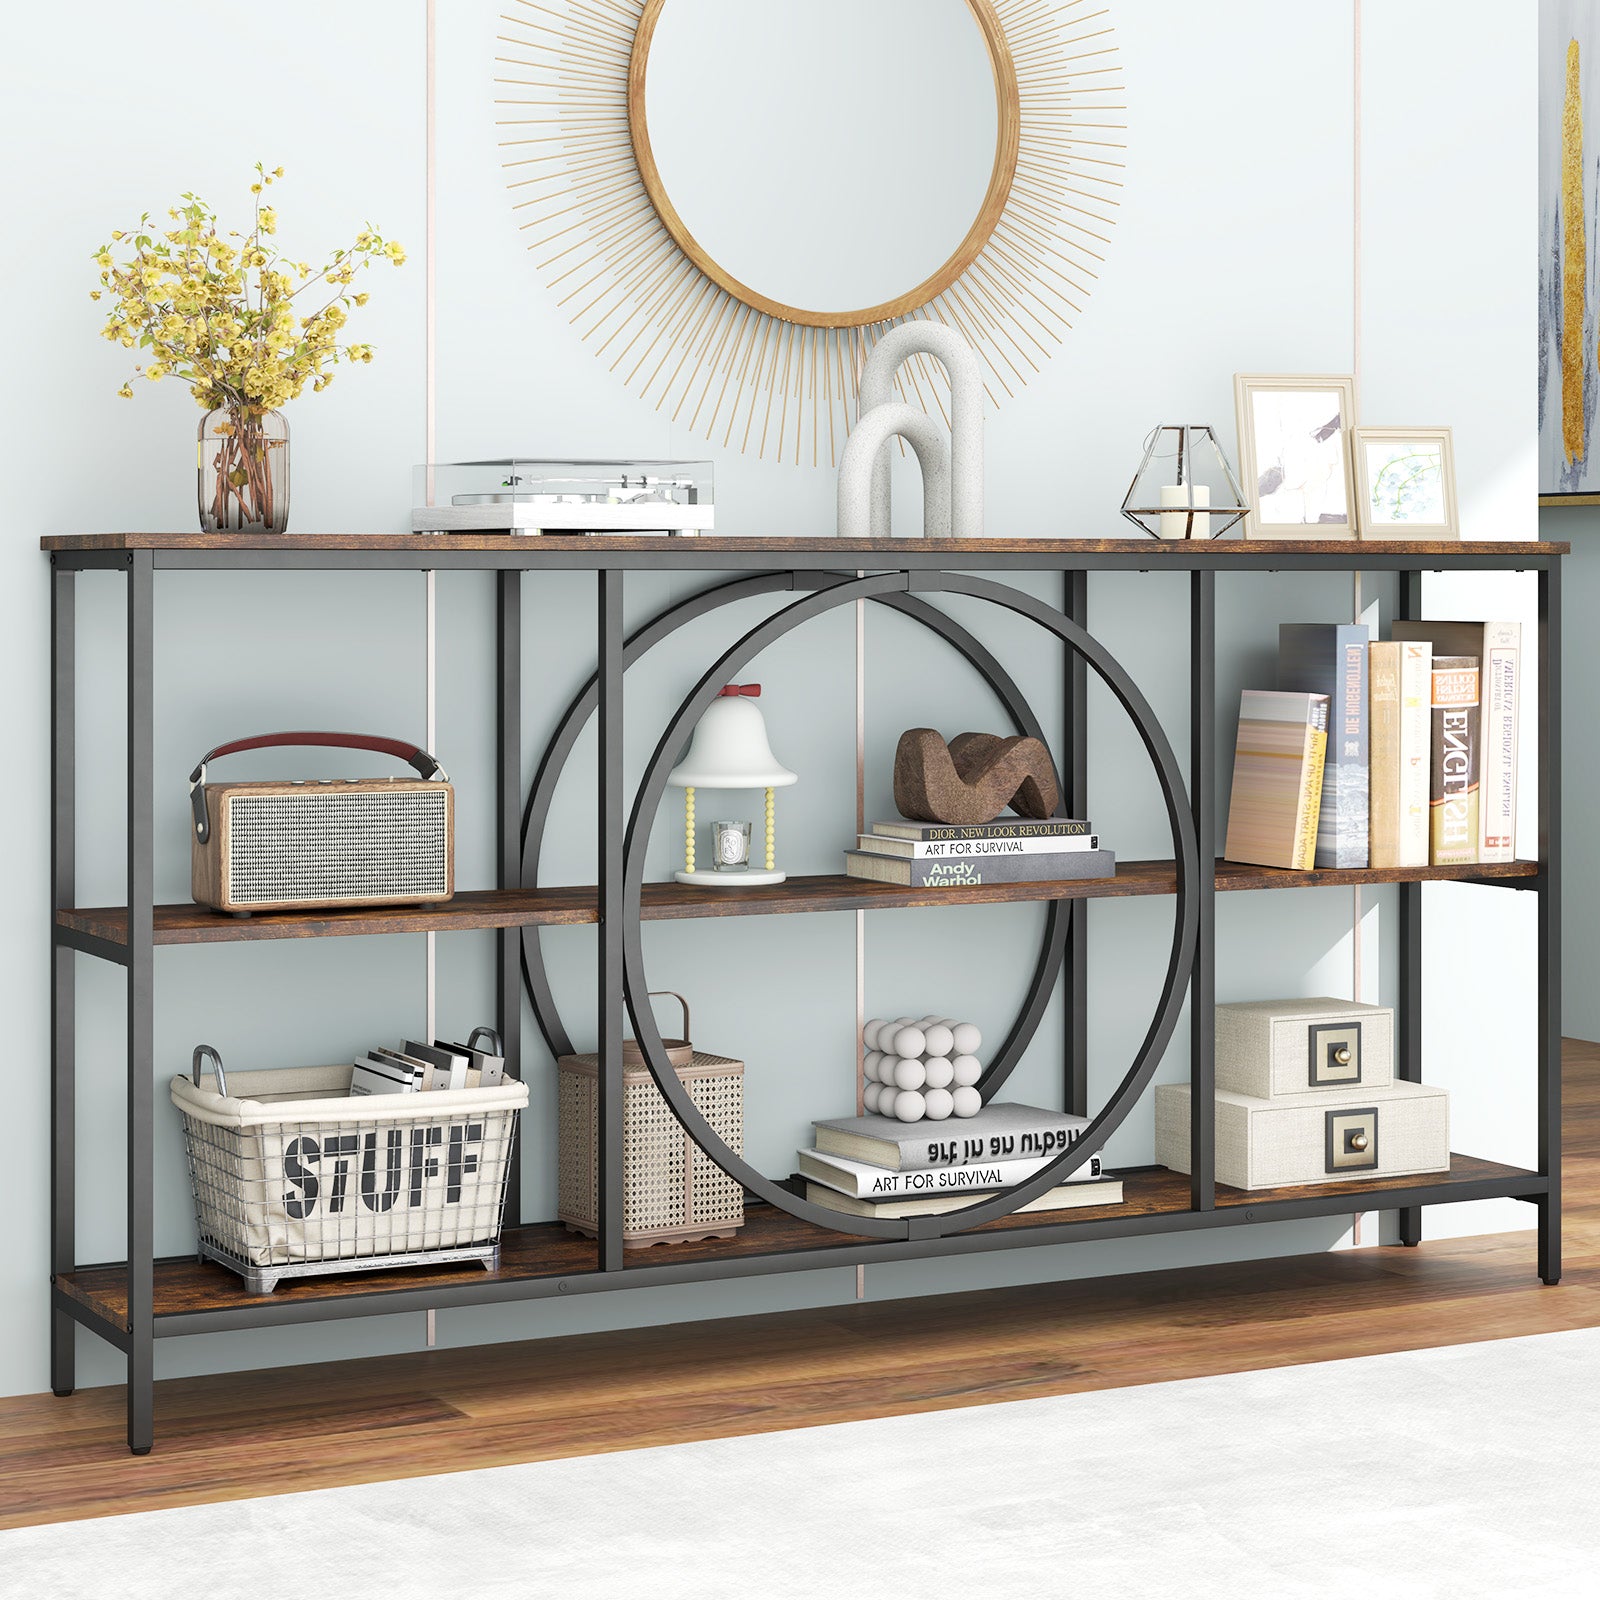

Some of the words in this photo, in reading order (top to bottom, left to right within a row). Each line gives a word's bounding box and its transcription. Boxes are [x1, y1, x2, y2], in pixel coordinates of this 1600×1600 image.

[960, 827, 985, 839] NEW
[986, 826, 1017, 838] LOOK
[1019, 823, 1086, 837] REVOLUTION
[925, 843, 946, 856] ART
[950, 842, 972, 855] FOR
[975, 841, 1023, 854] SURVIVAL
[929, 862, 976, 877] Andy
[922, 873, 982, 887] Warhol
[282, 1124, 483, 1219] STUFF
[872, 1175, 899, 1193] ART
[905, 1172, 935, 1190] FOR
[938, 1168, 1003, 1188] SURVIVAL
